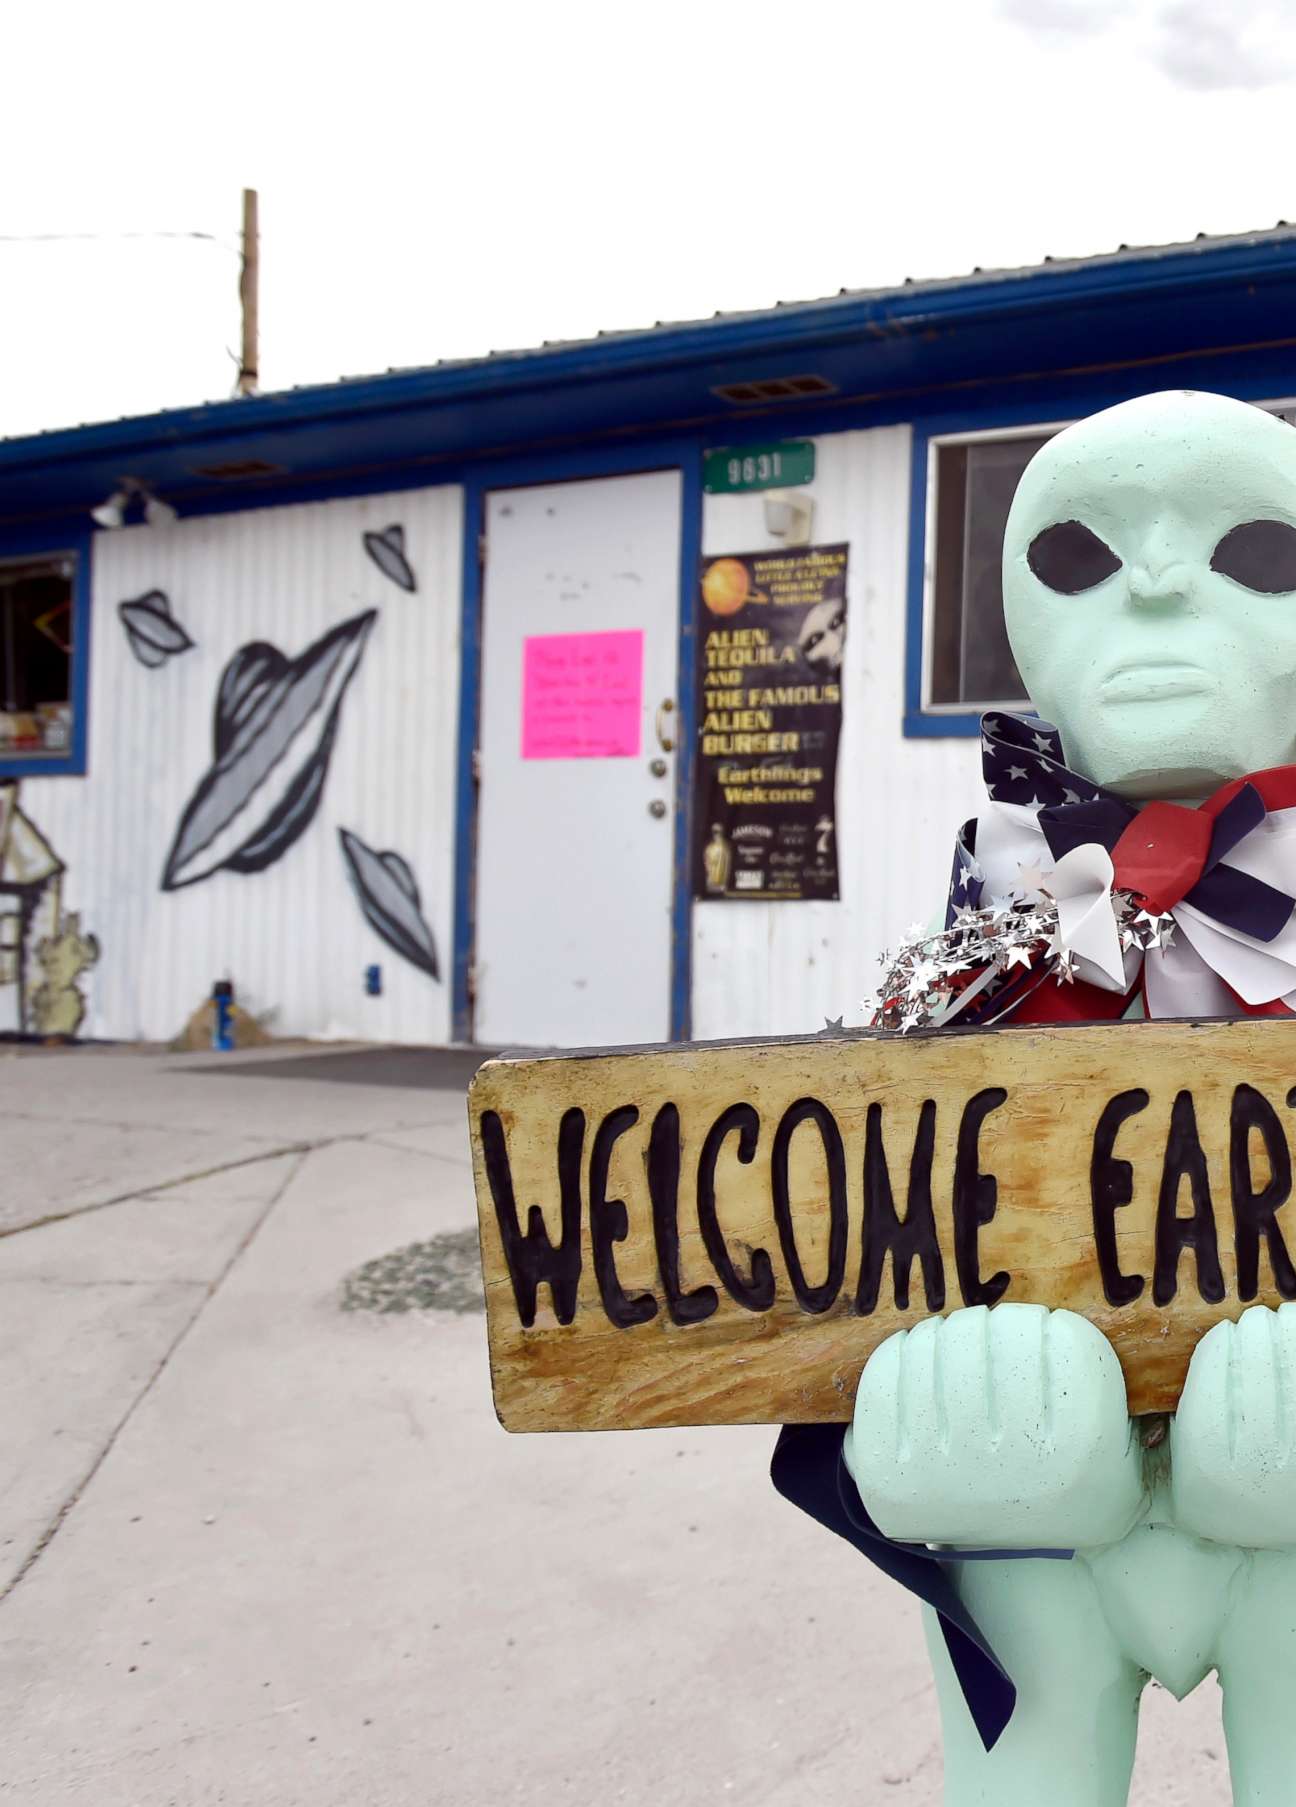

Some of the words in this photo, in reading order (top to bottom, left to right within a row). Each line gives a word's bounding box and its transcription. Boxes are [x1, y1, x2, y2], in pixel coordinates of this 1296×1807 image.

[706, 628, 768, 647] ALIEN
[706, 645, 796, 669] TEQUILA
[704, 669, 741, 686] AND
[706, 689, 742, 708] THE
[749, 684, 840, 707] FAMOUS
[703, 709, 771, 731] ALIEN
[703, 731, 799, 756] BURGER
[717, 765, 823, 786] Earthlings
[479, 1086, 1009, 1329] WELCOME
